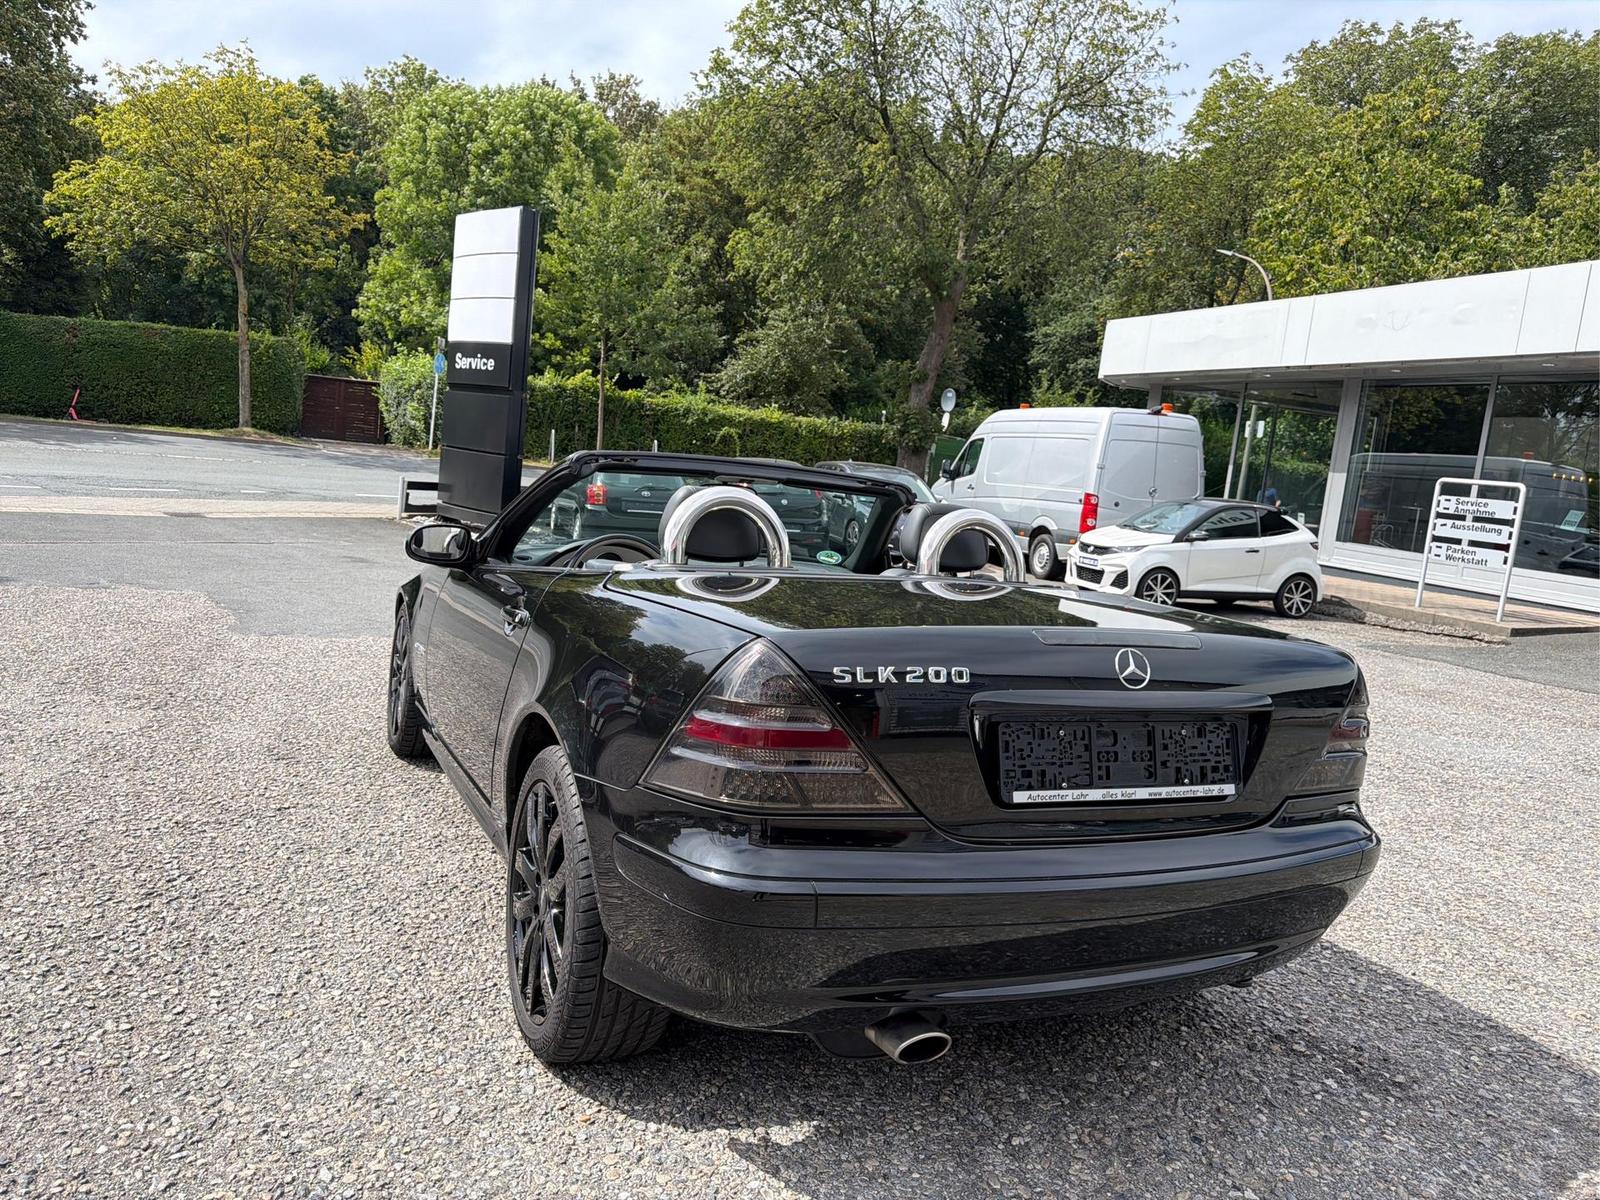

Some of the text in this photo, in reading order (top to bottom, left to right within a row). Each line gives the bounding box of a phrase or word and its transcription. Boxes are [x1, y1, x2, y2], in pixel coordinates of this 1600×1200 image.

[455, 352, 495, 371] Service
[1455, 498, 1489, 508] Service
[1454, 506, 1496, 517] Annahme
[1450, 522, 1503, 536] Ausstellung
[1446, 545, 1477, 556] Parken
[1445, 554, 1488, 566] Werkstatt
[832, 666, 970, 683] SLK 200
[1027, 793, 1069, 801] Autocenter
[1071, 791, 1089, 800] Lahr
